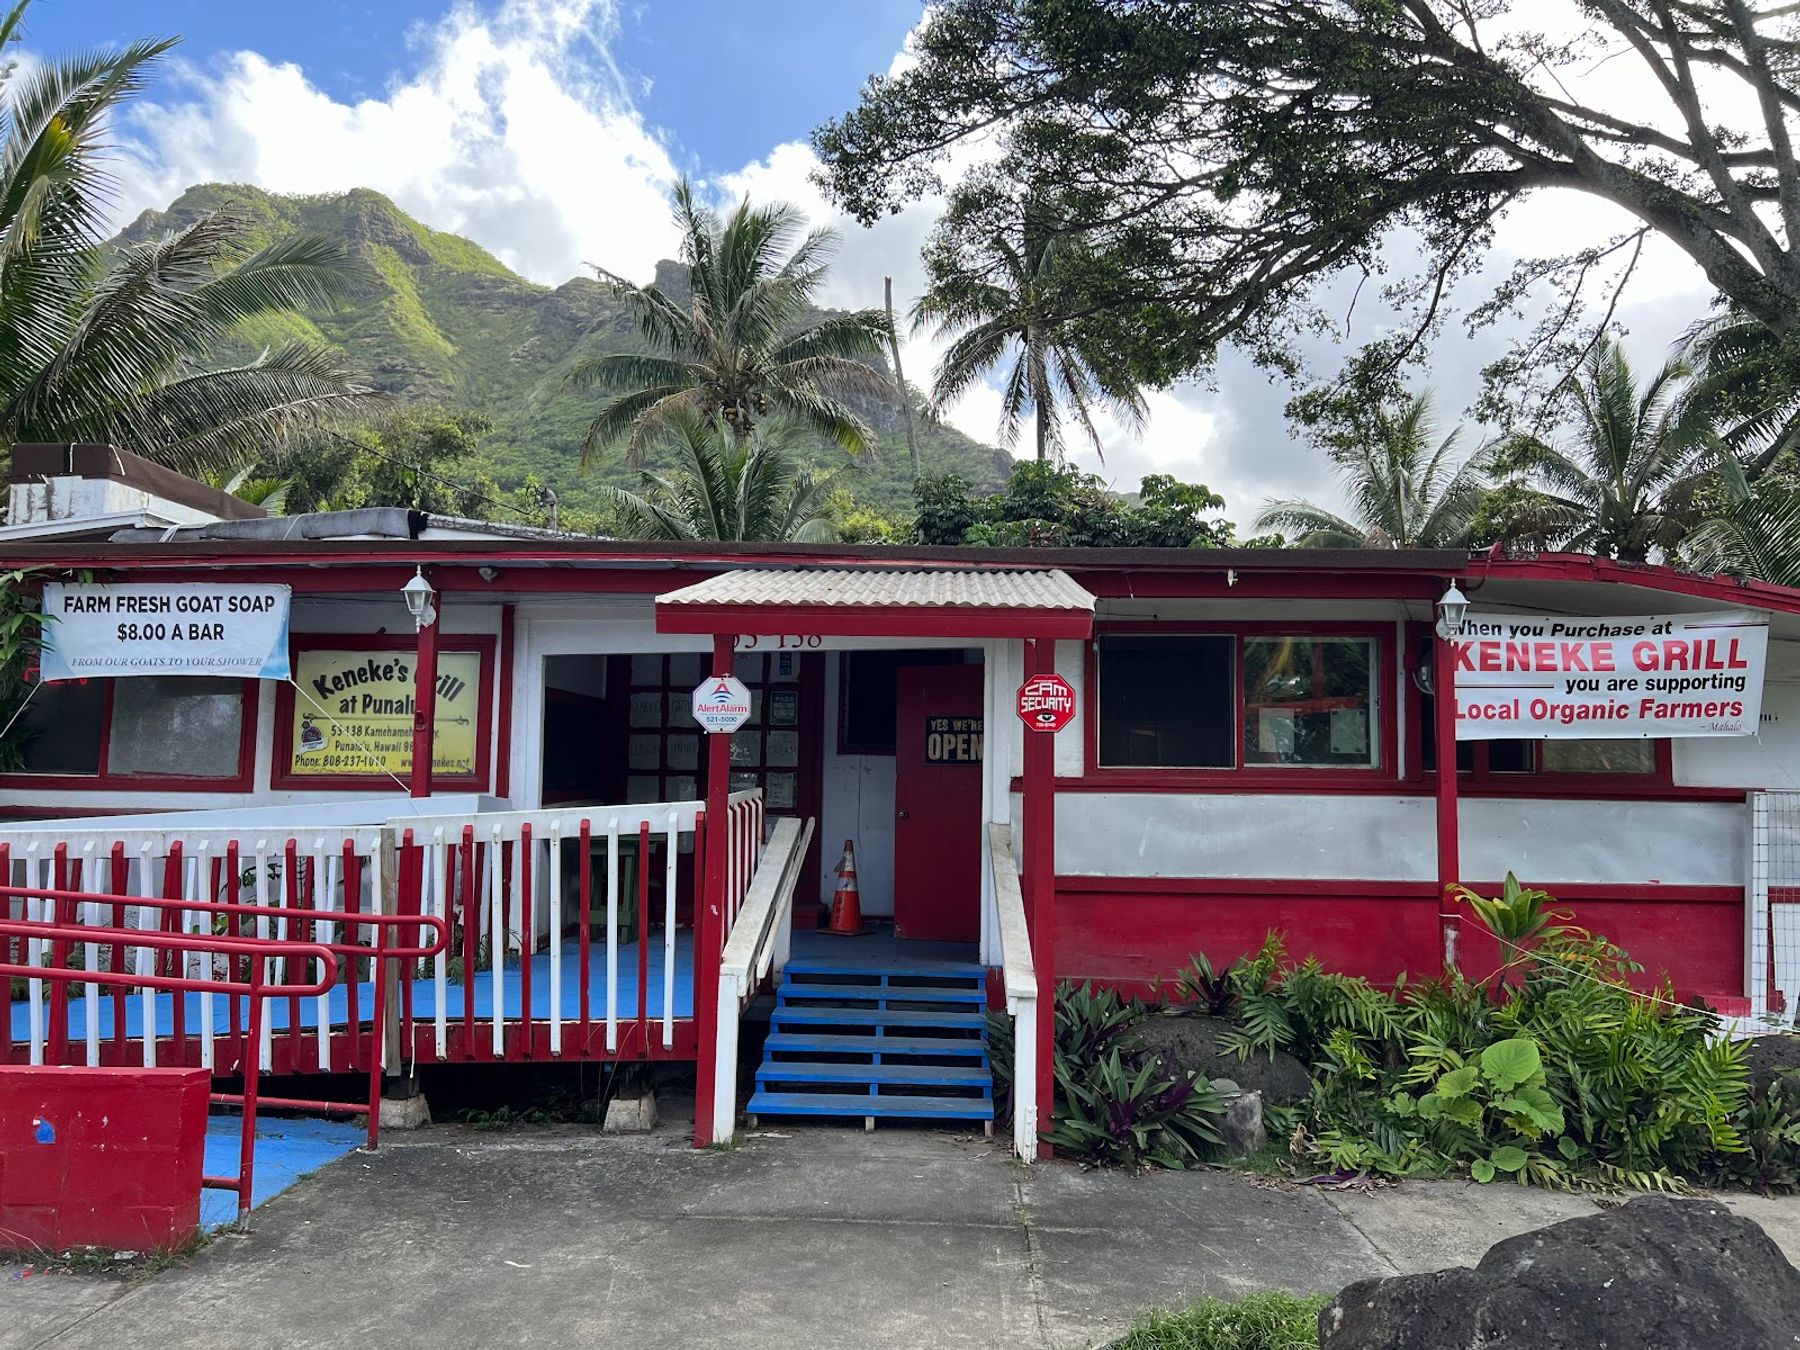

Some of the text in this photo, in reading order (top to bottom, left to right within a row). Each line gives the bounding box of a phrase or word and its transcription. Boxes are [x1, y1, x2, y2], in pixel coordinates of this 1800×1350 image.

[64, 595, 275, 613] FARM FRESH GOAT SOAP
[117, 623, 224, 642] $8.00 A BAR
[1509, 624, 1544, 639] you
[1550, 622, 1645, 637] Purchase
[1651, 621, 1673, 635] at
[72, 657, 262, 667] FROM OUR GOATS TO YOUR SHOWER
[1454, 638, 1748, 672] KENEKE GRILL
[312, 658, 409, 700] Keneke's
[1565, 673, 1746, 694] you are supporting
[1025, 682, 1067, 696] CAM
[339, 696, 358, 714] at
[1021, 697, 1071, 713] SECURITY
[1455, 697, 1743, 724] Local Organic Farmers
[931, 719, 983, 731] YES WE'RE
[374, 741, 401, 752] Hawaii
[928, 733, 983, 760] OPEN
[295, 755, 321, 767] Phone:
